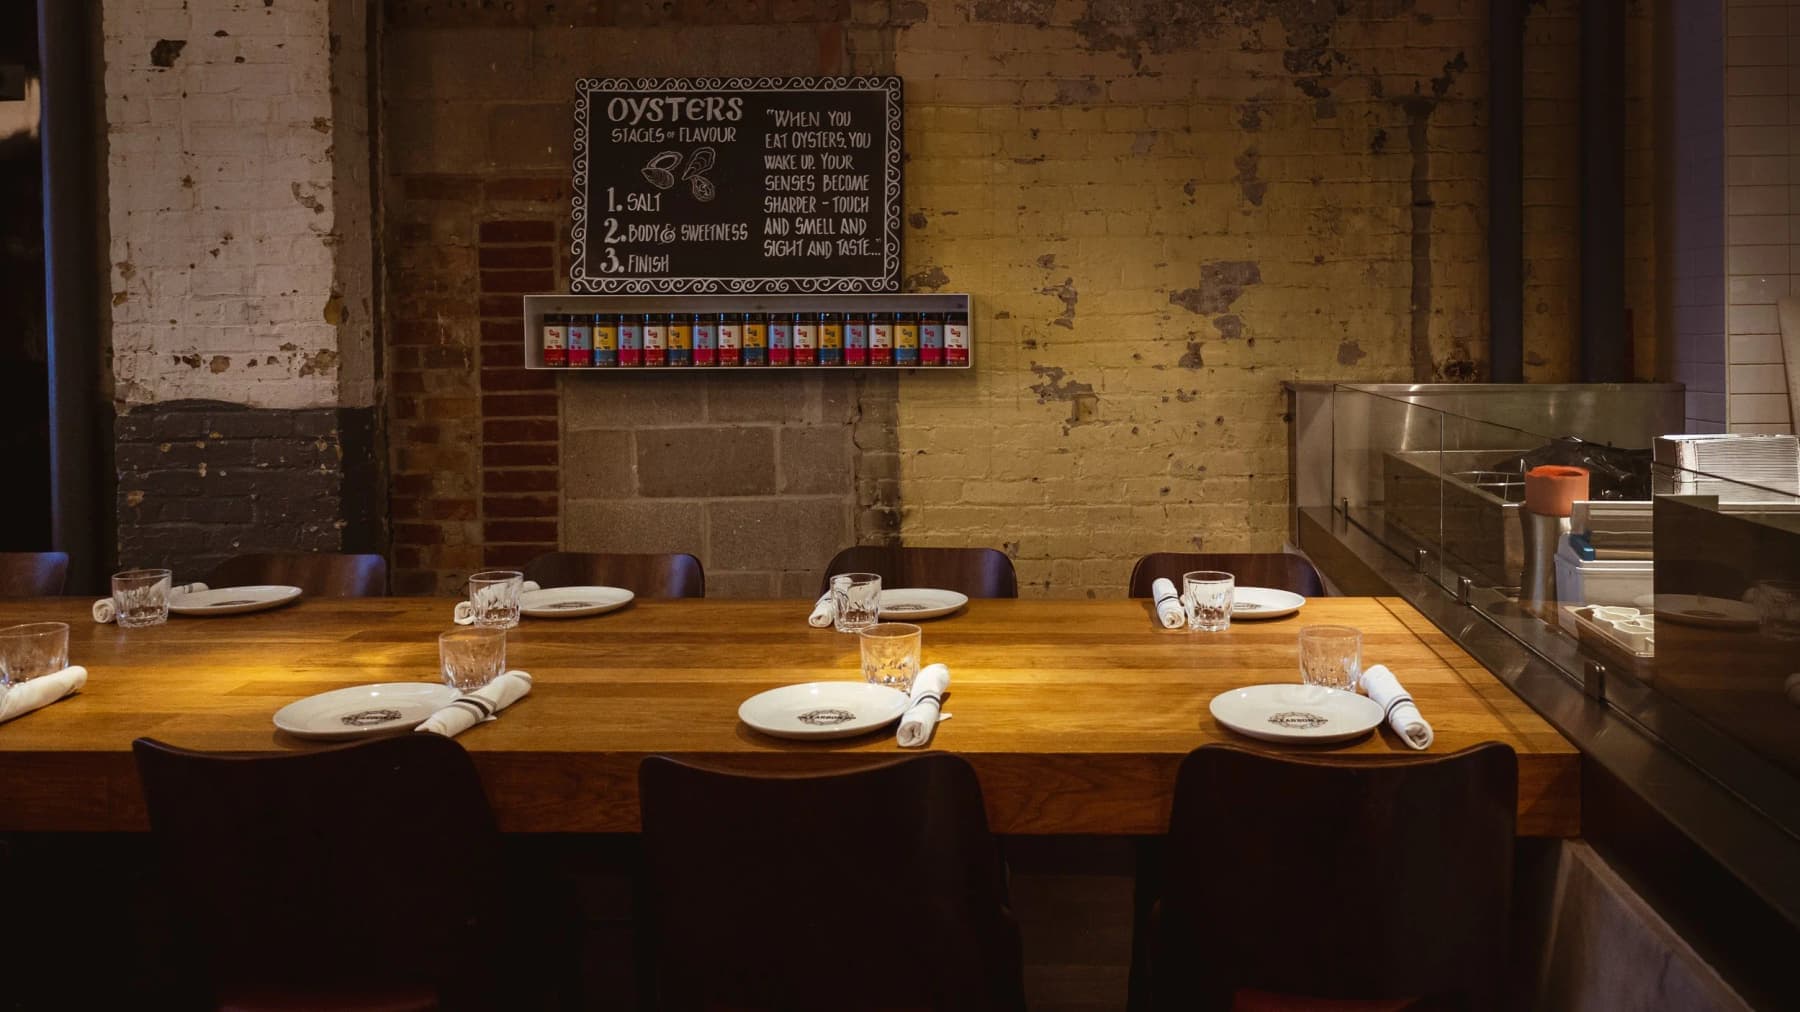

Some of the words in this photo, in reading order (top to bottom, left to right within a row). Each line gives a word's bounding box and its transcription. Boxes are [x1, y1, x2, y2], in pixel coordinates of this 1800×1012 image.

[608, 97, 743, 125] OYSTERS
[828, 111, 851, 127] YOU
[612, 127, 665, 143] STAGES
[680, 127, 736, 142] FLAVOUR
[765, 133, 788, 149] EAT
[849, 132, 871, 149] YOU
[764, 155, 797, 170] WAKE
[801, 155, 816, 170] UP.
[821, 152, 854, 170] YOUR
[765, 175, 815, 191] SENSES
[823, 175, 870, 192] BECOME
[607, 187, 623, 212] 1.
[627, 192, 661, 212] SALT
[764, 196, 816, 213] SHARPER
[832, 196, 869, 213] TOUCH
[604, 218, 627, 244] 2.
[682, 223, 748, 241] SWEETNESS
[764, 217, 789, 236] AND
[795, 217, 836, 234] SMELL
[840, 218, 867, 235] AND
[764, 240, 803, 257] SIGHT
[807, 241, 832, 259] AND
[600, 247, 624, 273] 3.
[628, 254, 669, 273] FINISH
